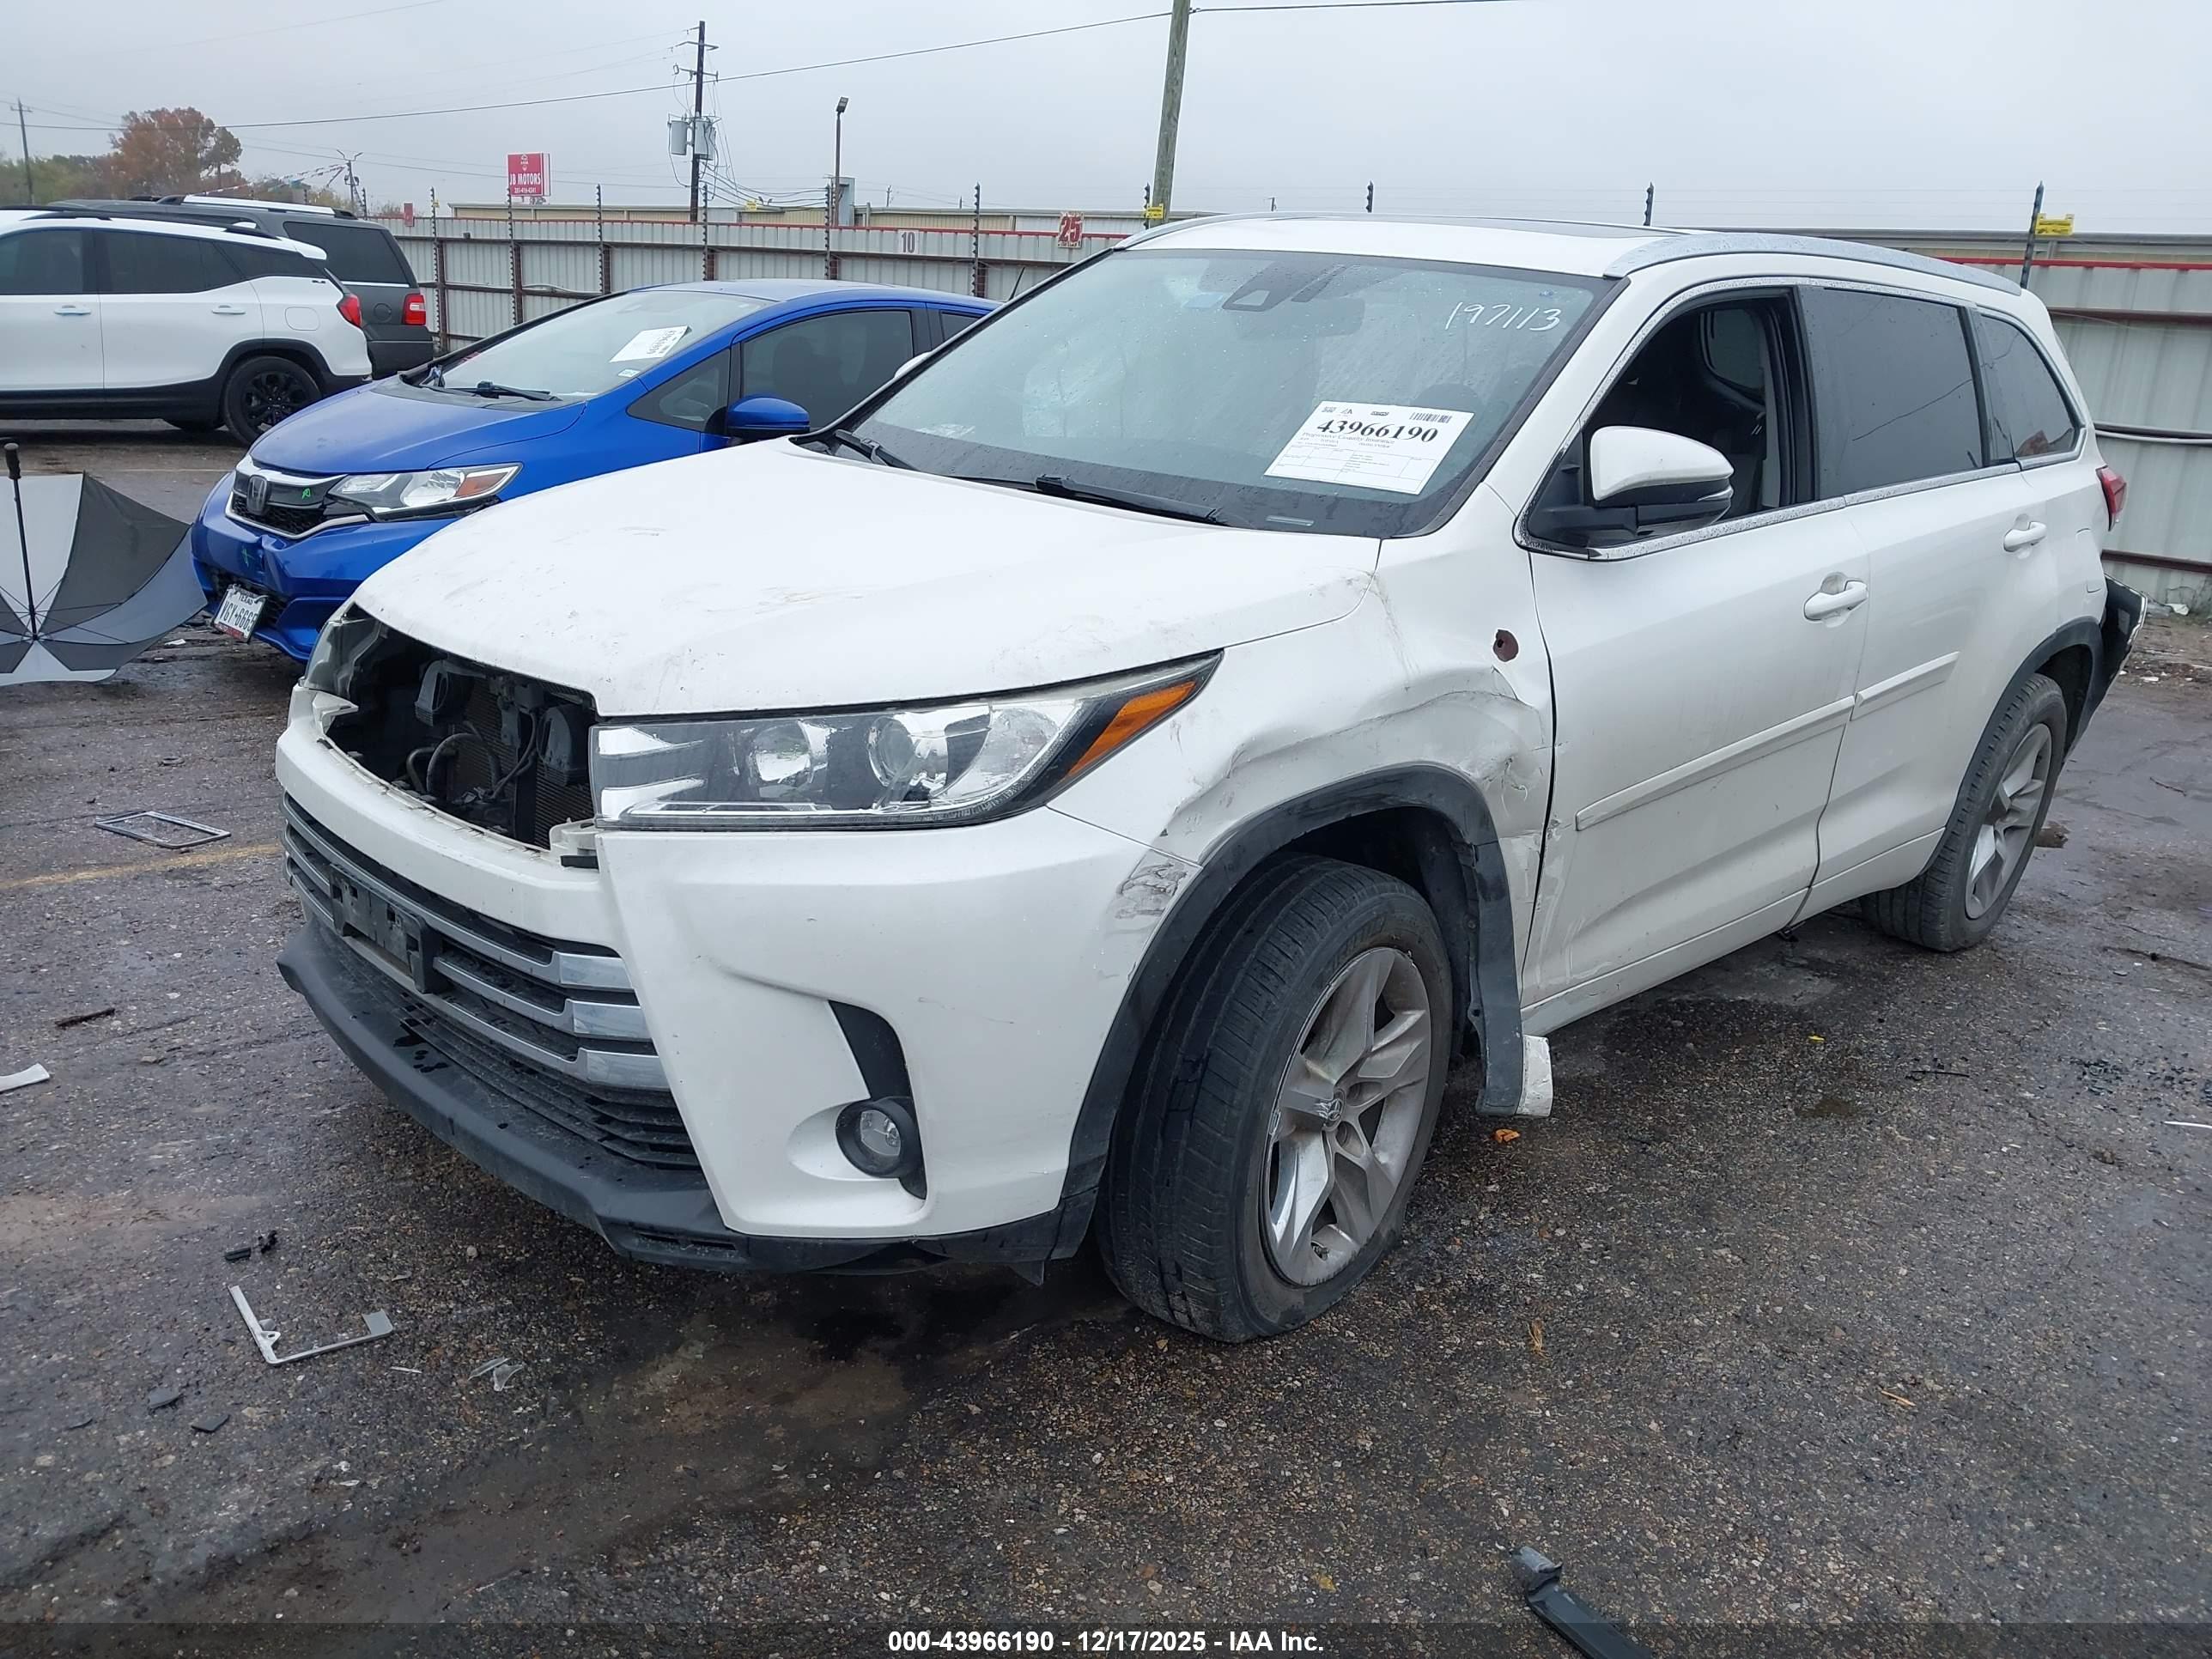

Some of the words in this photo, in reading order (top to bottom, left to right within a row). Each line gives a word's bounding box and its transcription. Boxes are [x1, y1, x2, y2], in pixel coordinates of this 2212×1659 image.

[518, 173, 541, 185] MOTORS
[1058, 216, 1082, 242] 25
[902, 231, 915, 253] 10
[1444, 301, 1562, 331] 197113
[1316, 419, 1439, 443] 43966190
